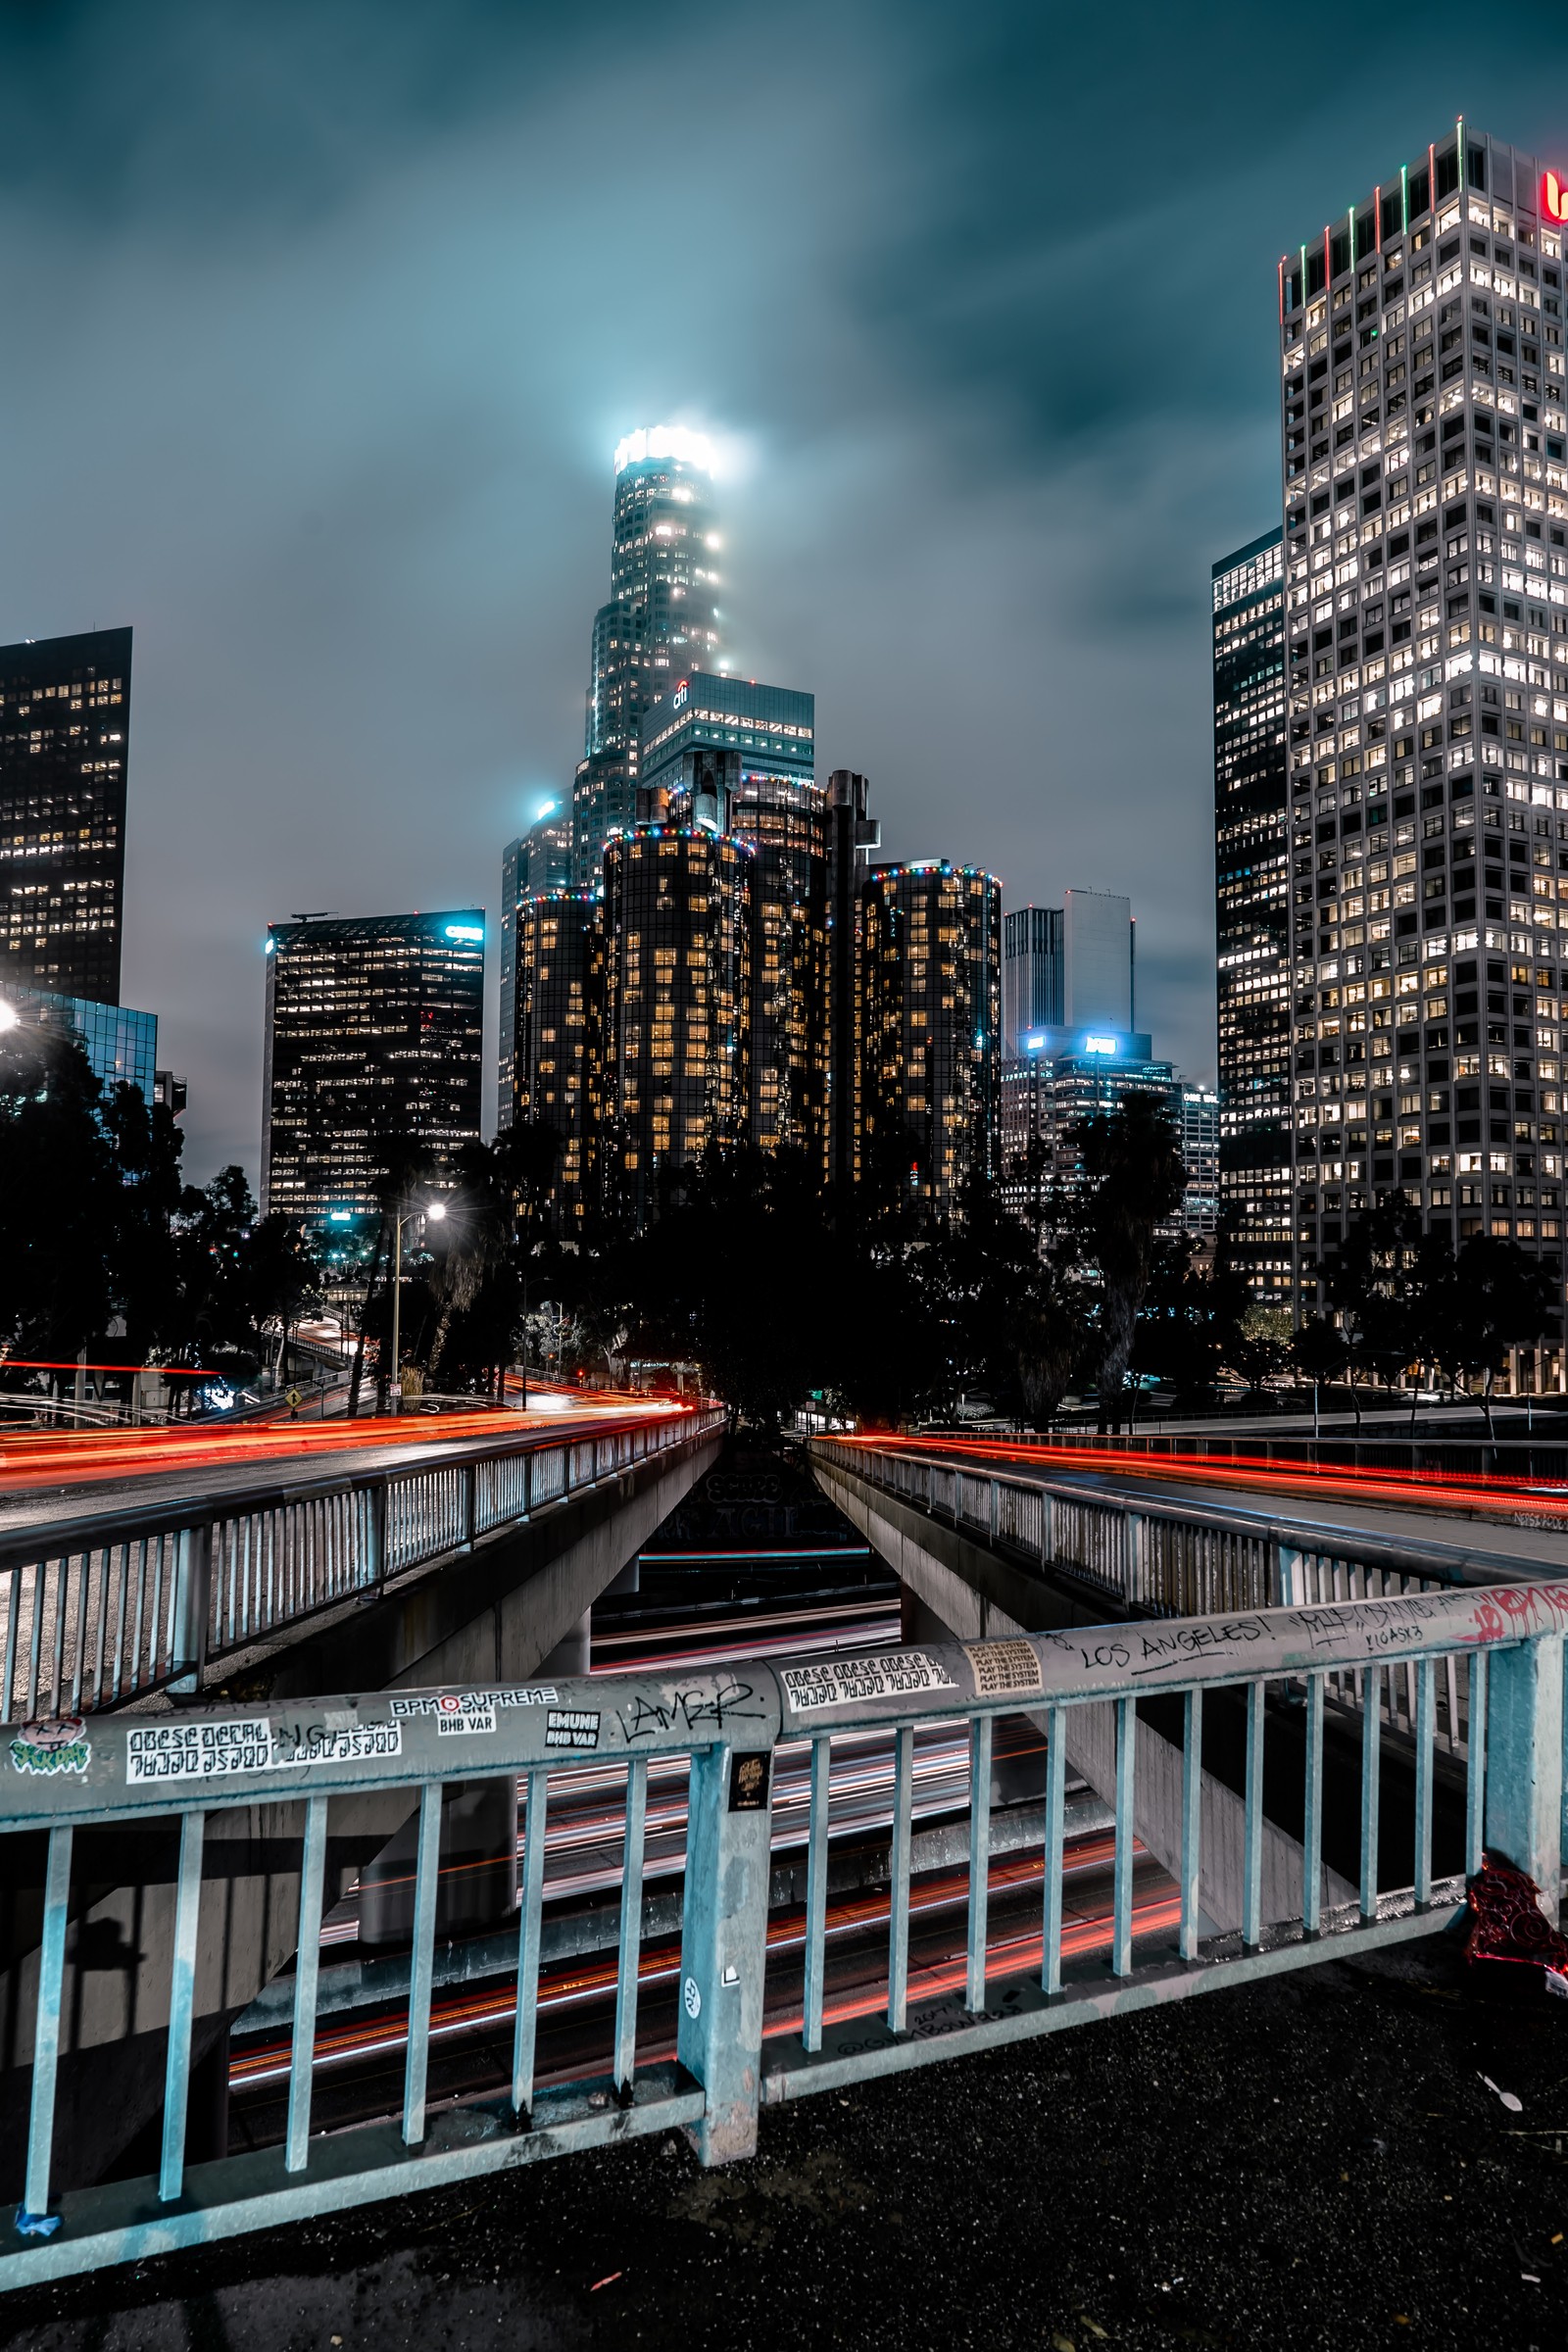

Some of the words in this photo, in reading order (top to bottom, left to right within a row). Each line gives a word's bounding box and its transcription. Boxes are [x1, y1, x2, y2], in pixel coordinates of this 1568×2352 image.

[1080, 1642, 1130, 1669] LOS
[1010, 1661, 1038, 1670] SYSTEM
[980, 1674, 998, 1683] PLAY
[1012, 1670, 1039, 1679] SYSTEM
[981, 1683, 999, 1691] PLAY
[1013, 1678, 1040, 1688] SYSTEM
[441, 1718, 465, 1733] BHB
[468, 1717, 492, 1731] VAR
[548, 1712, 599, 1730] EMUNE
[572, 1732, 597, 1745] VAR
